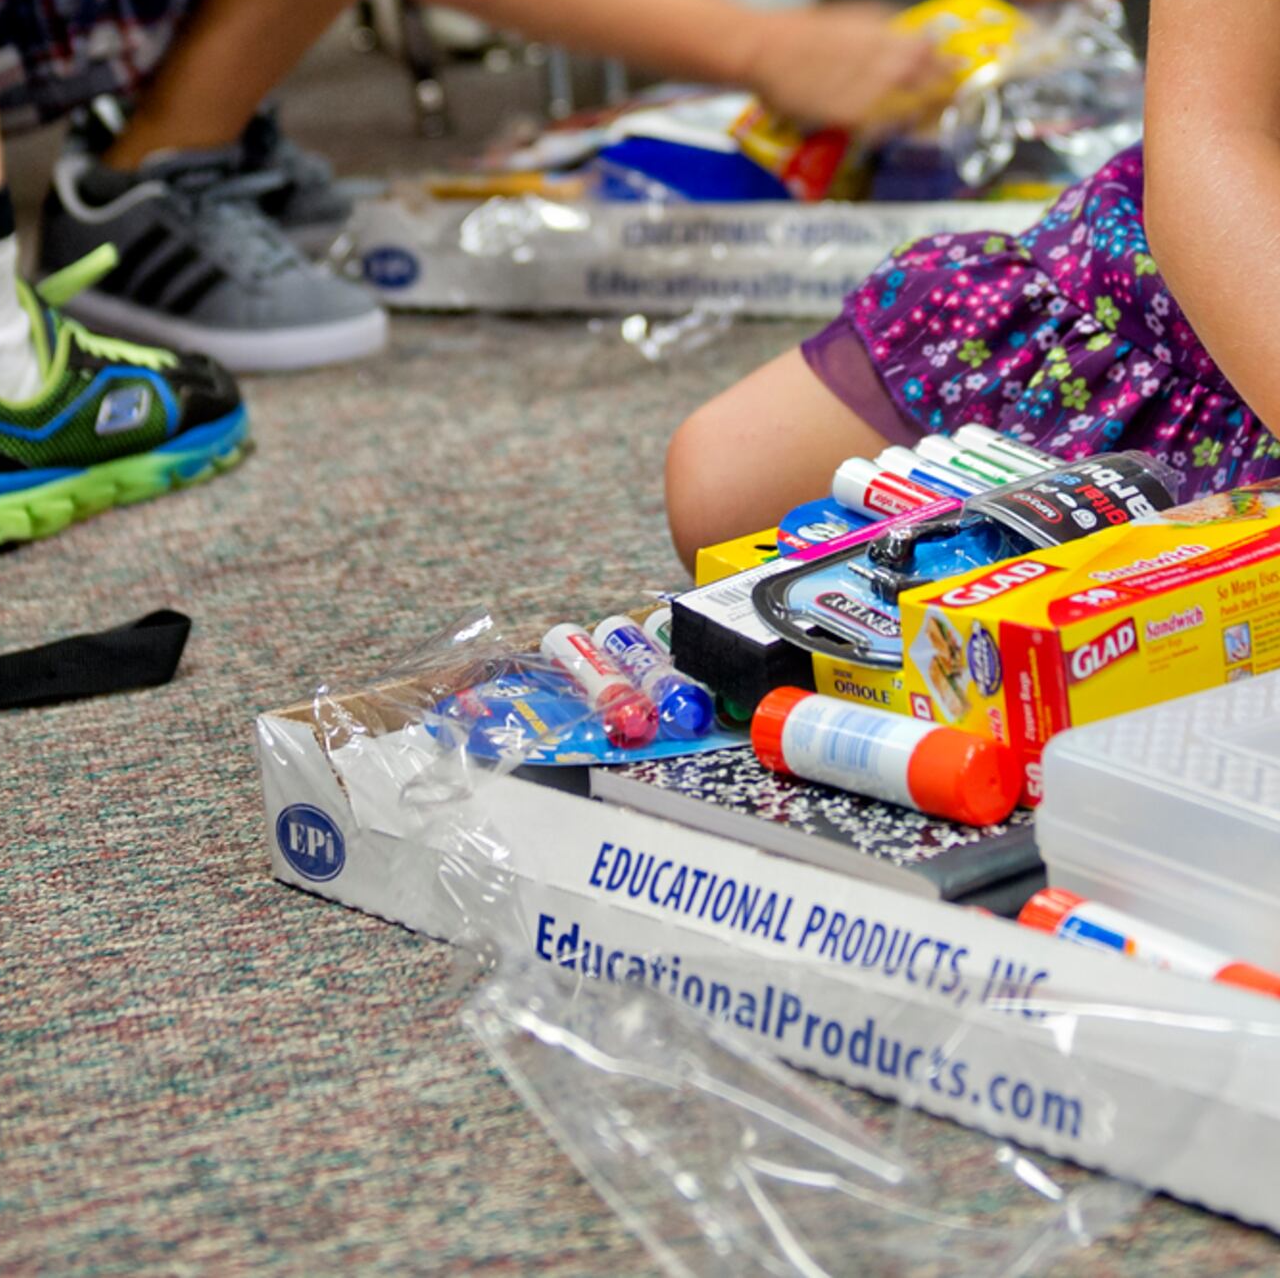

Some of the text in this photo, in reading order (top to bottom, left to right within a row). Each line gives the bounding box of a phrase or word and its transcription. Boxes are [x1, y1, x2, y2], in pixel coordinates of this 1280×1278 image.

[941, 560, 1048, 606] GLAD
[1145, 605, 1205, 642] Sandwich
[1071, 623, 1136, 680] GLAD
[833, 678, 892, 705] ORIOLE
[588, 840, 793, 945] EDUCATIONAL
[798, 903, 971, 1006] PRODUCTS,
[534, 913, 1085, 1140] EducationalProducts.com
